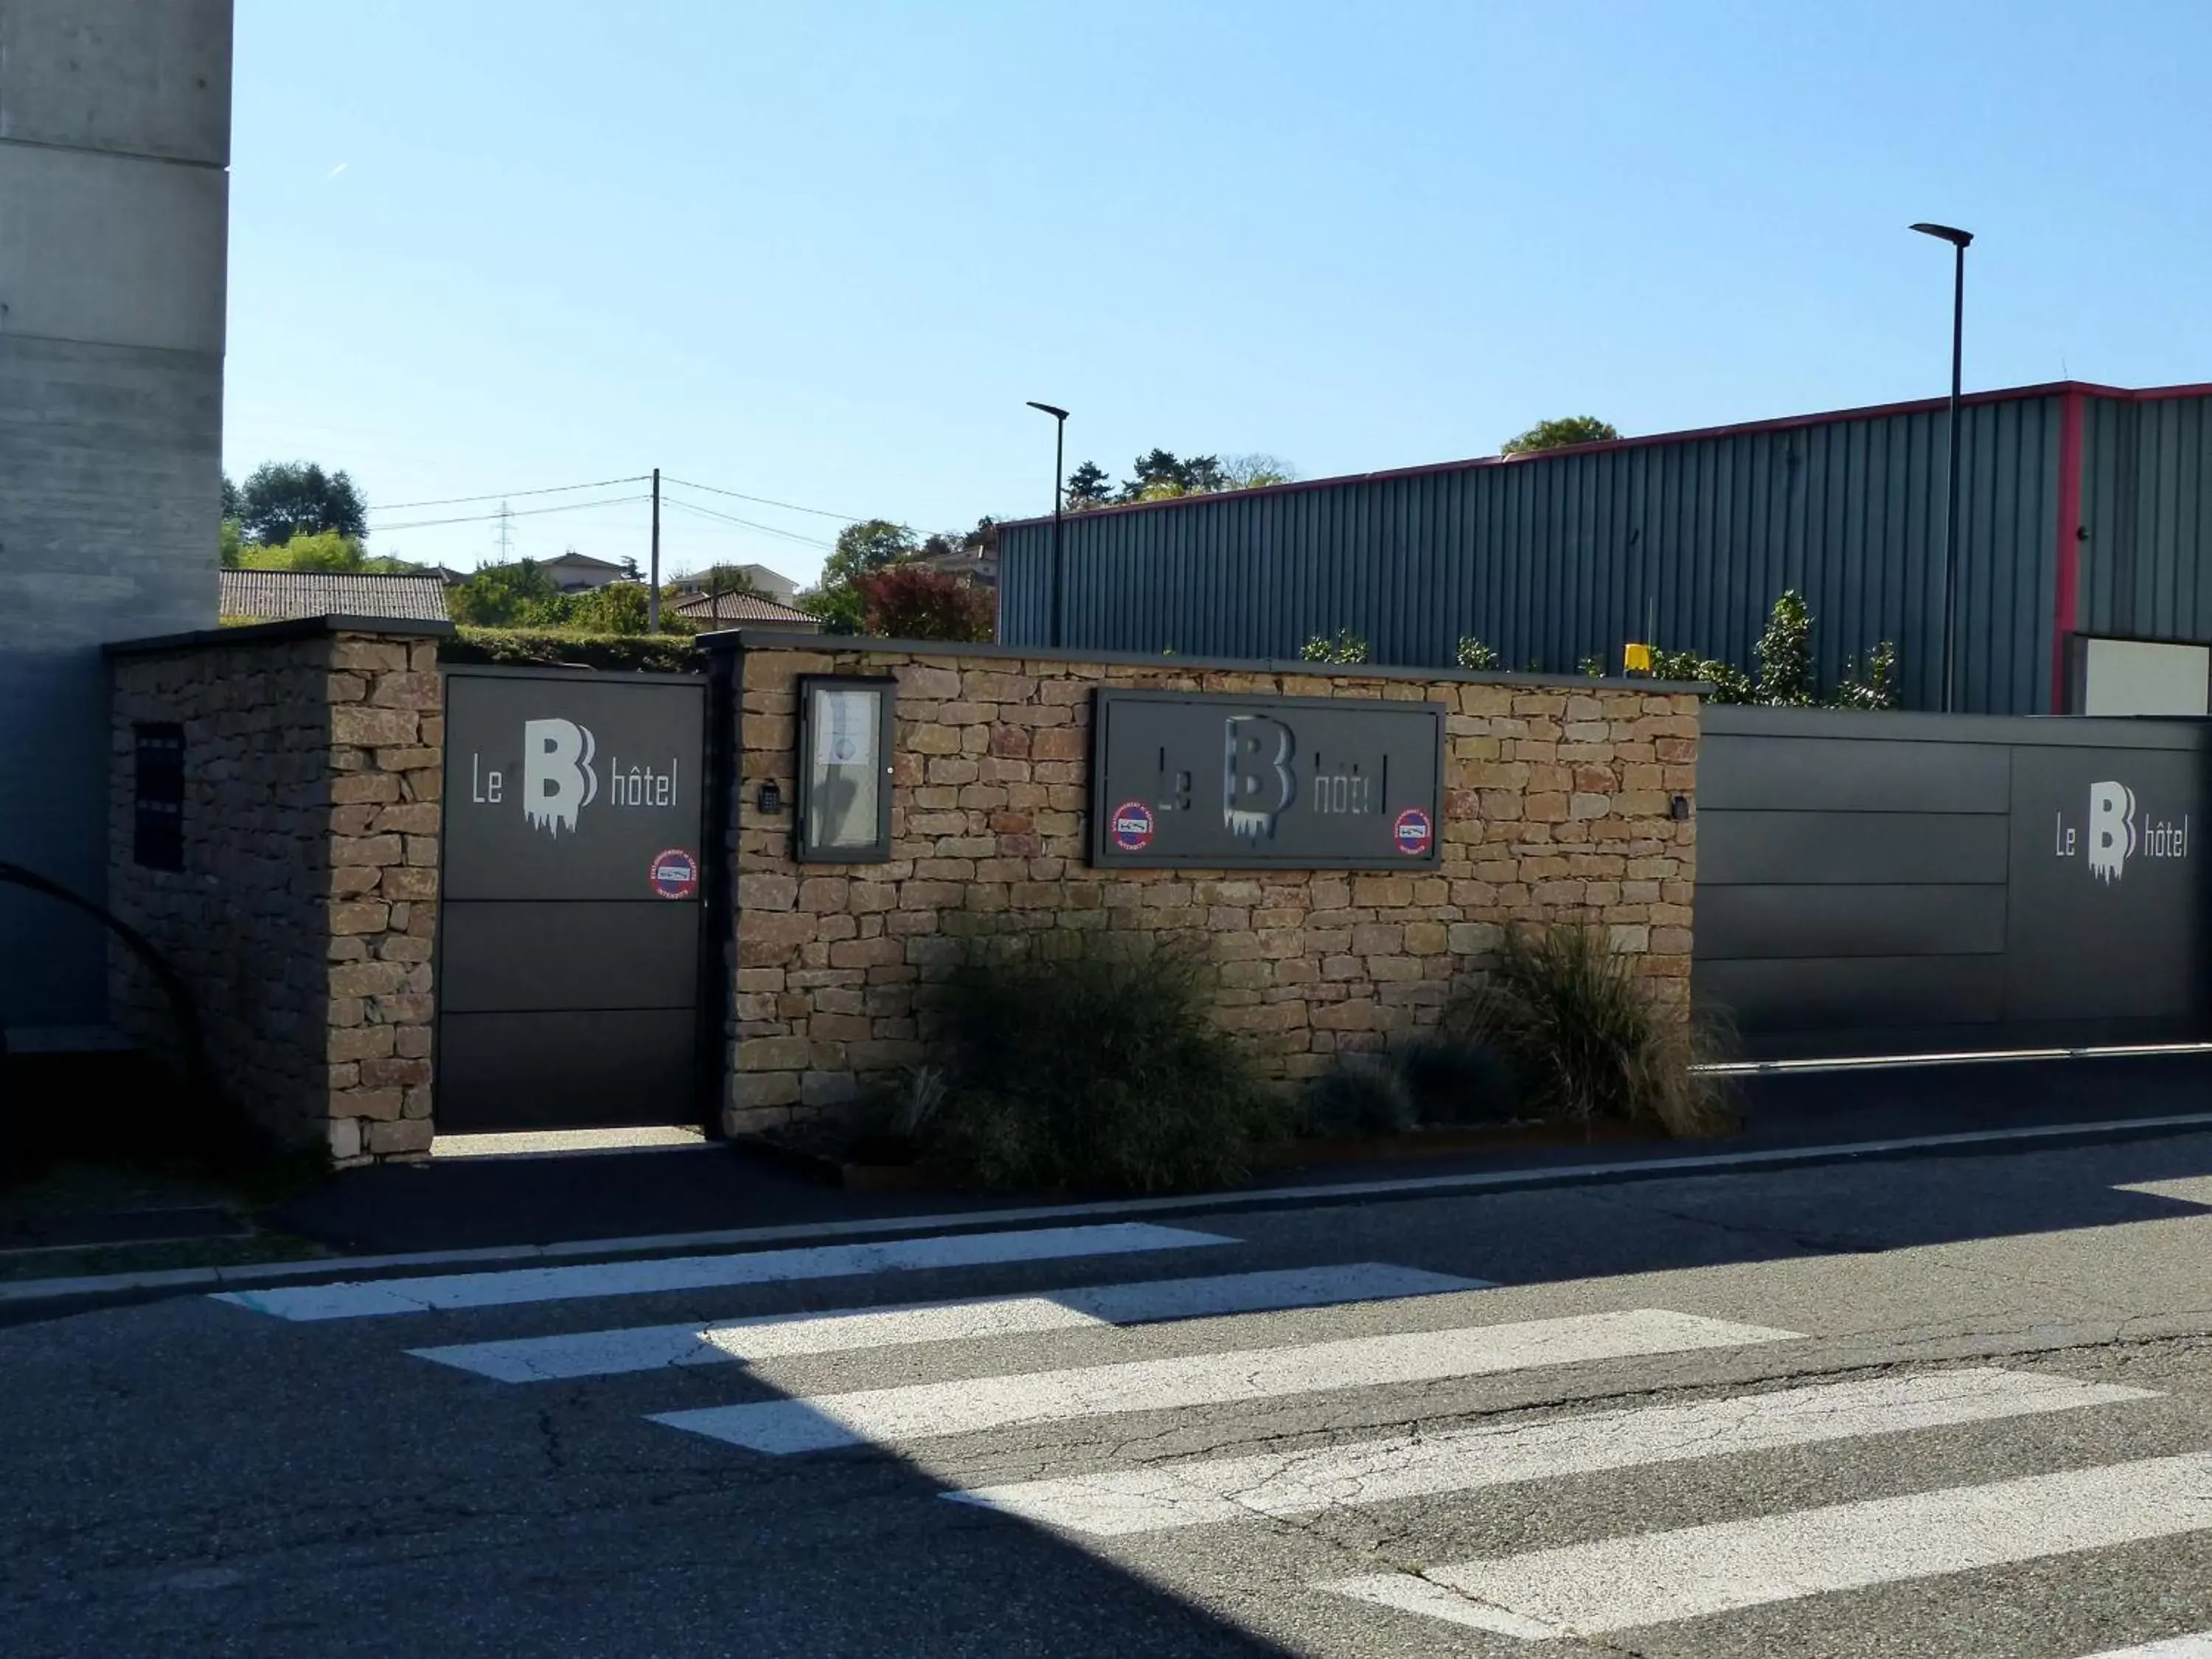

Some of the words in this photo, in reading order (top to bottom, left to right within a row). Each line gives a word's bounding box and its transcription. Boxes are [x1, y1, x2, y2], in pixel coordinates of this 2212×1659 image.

[473, 753, 503, 804] Le
[524, 717, 599, 840] B
[611, 756, 678, 807] hôtel
[1223, 714, 1296, 849] B
[2056, 812, 2076, 856] Le
[2088, 781, 2137, 886] B
[2145, 813, 2188, 858] hôtel
